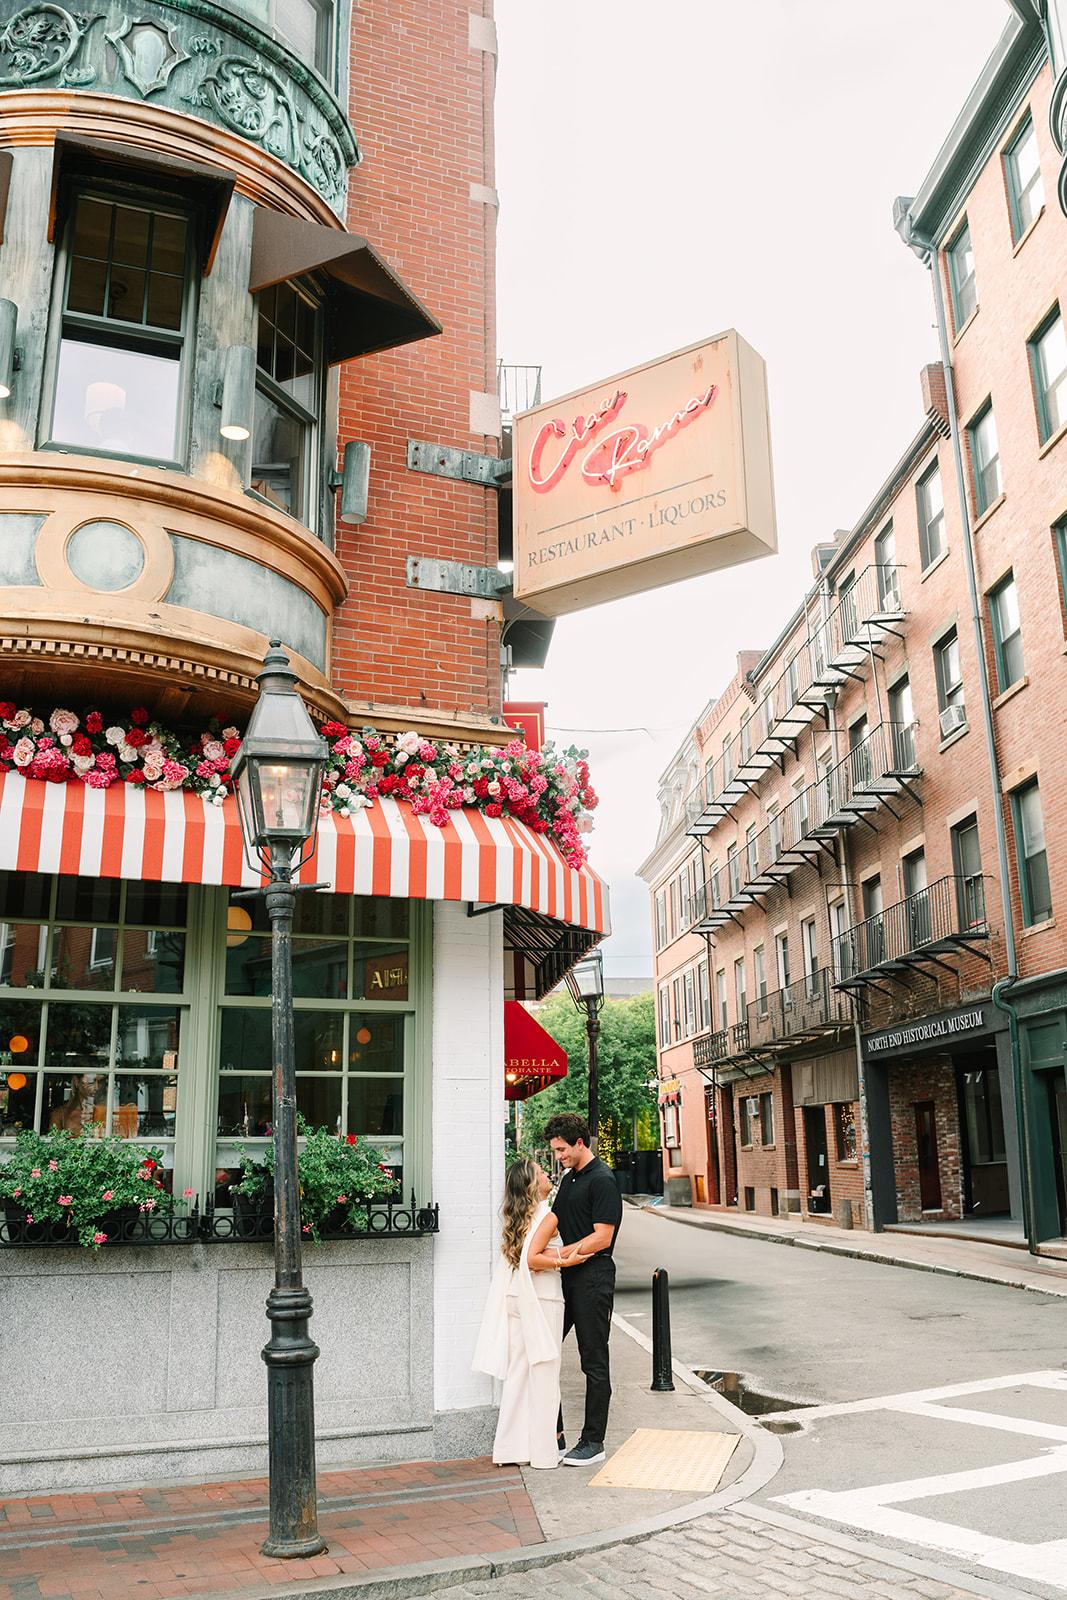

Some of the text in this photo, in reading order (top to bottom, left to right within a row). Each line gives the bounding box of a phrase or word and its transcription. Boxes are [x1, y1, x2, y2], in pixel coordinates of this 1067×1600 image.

[582, 384, 717, 486] Roma
[528, 489, 727, 567] RESTAURANT LIQUORS
[867, 1010, 983, 1052] NORTH END HISTORICAL MUSEUM
